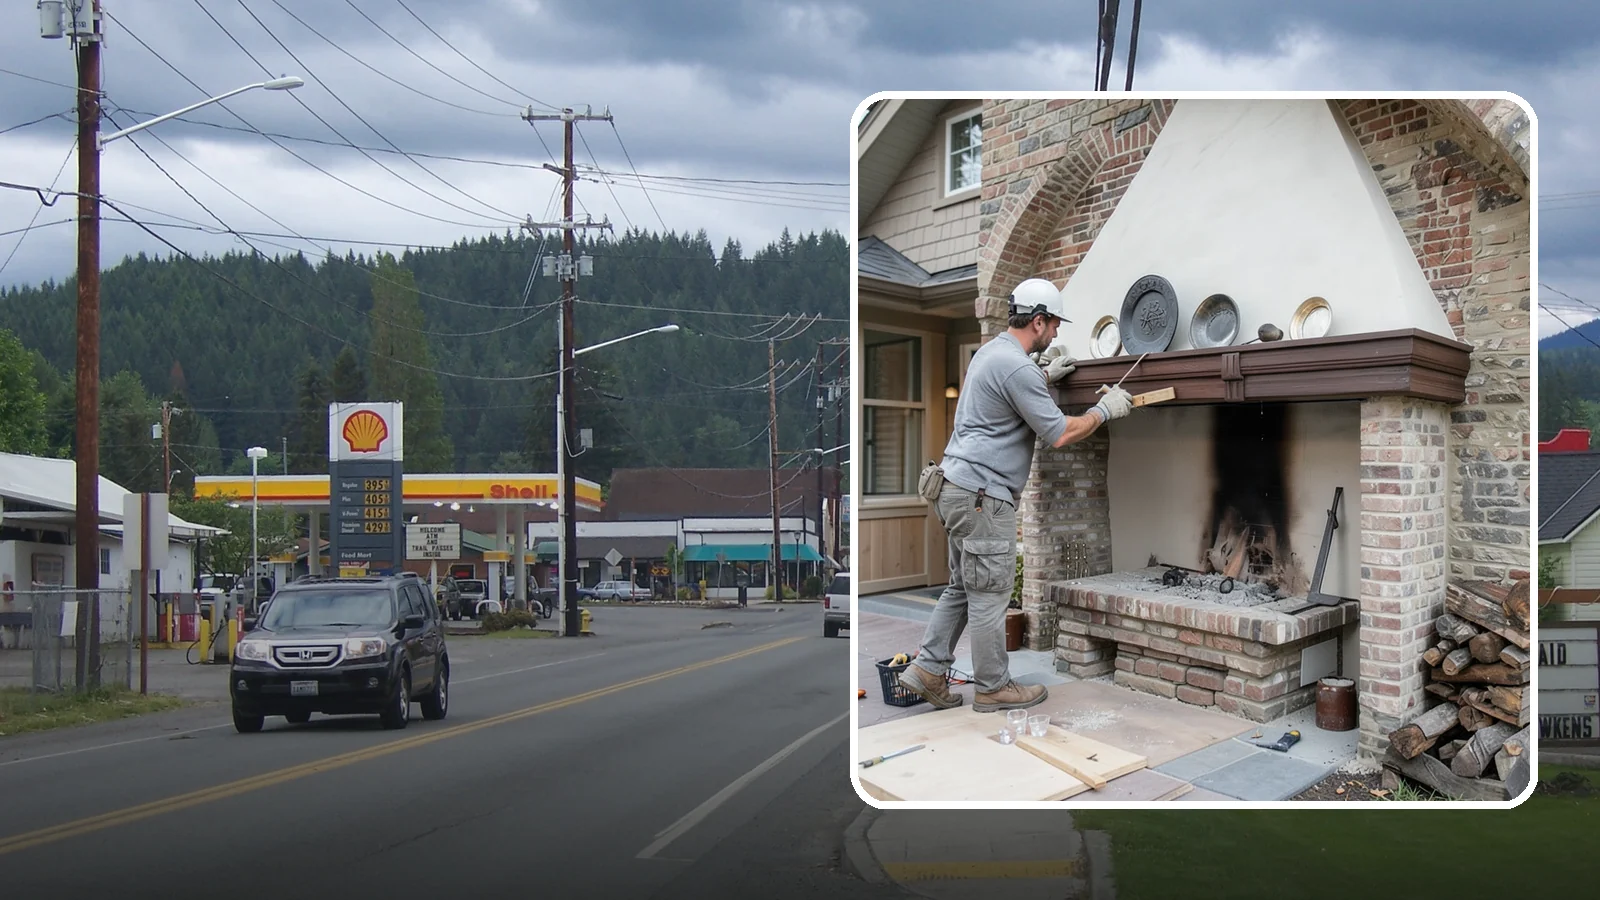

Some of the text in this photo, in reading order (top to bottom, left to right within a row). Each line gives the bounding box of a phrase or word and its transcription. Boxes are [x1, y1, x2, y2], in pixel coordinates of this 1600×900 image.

[366, 480, 384, 490] 395
[490, 484, 547, 499] Shell
[366, 494, 384, 504] 405
[366, 508, 384, 518] 415
[366, 522, 384, 533] 429
[1538, 642, 1567, 665] AID
